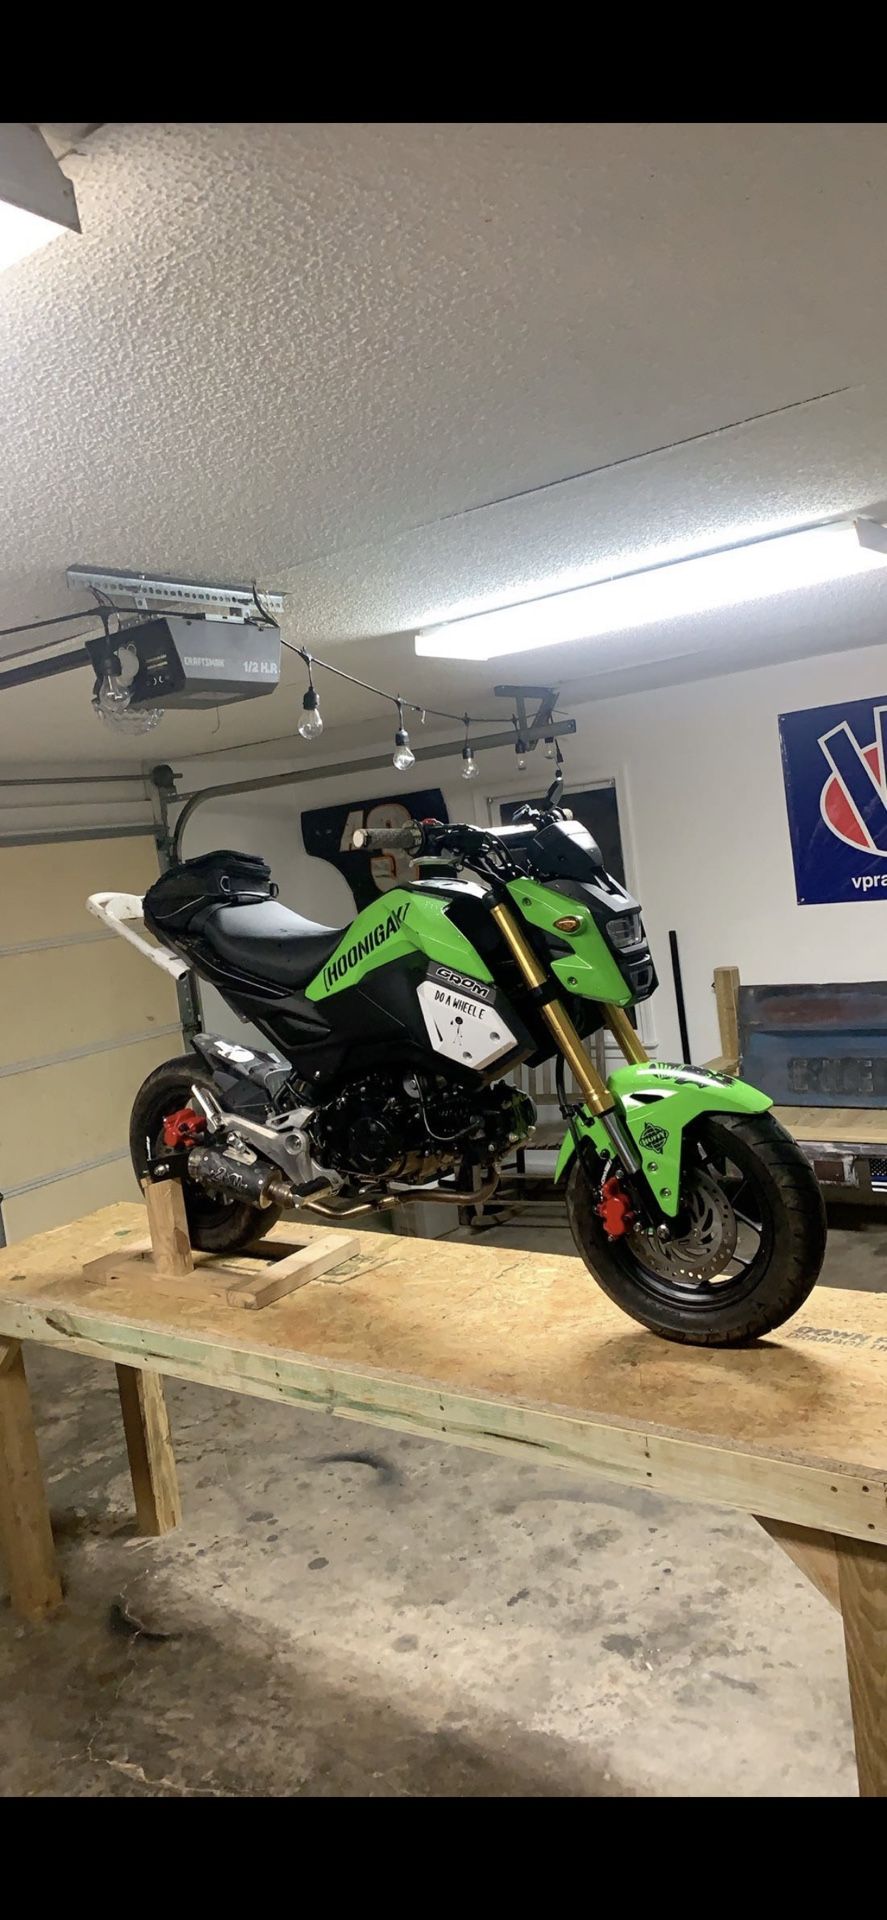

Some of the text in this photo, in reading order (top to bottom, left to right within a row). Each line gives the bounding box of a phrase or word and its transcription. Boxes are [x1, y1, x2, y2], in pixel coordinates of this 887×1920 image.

[184, 656, 225, 668] CRAFTSMAN
[243, 660, 258, 673] 1/2
[436, 967, 490, 998] GROM
[434, 990, 446, 1003] DO
[445, 995, 452, 1007] A
